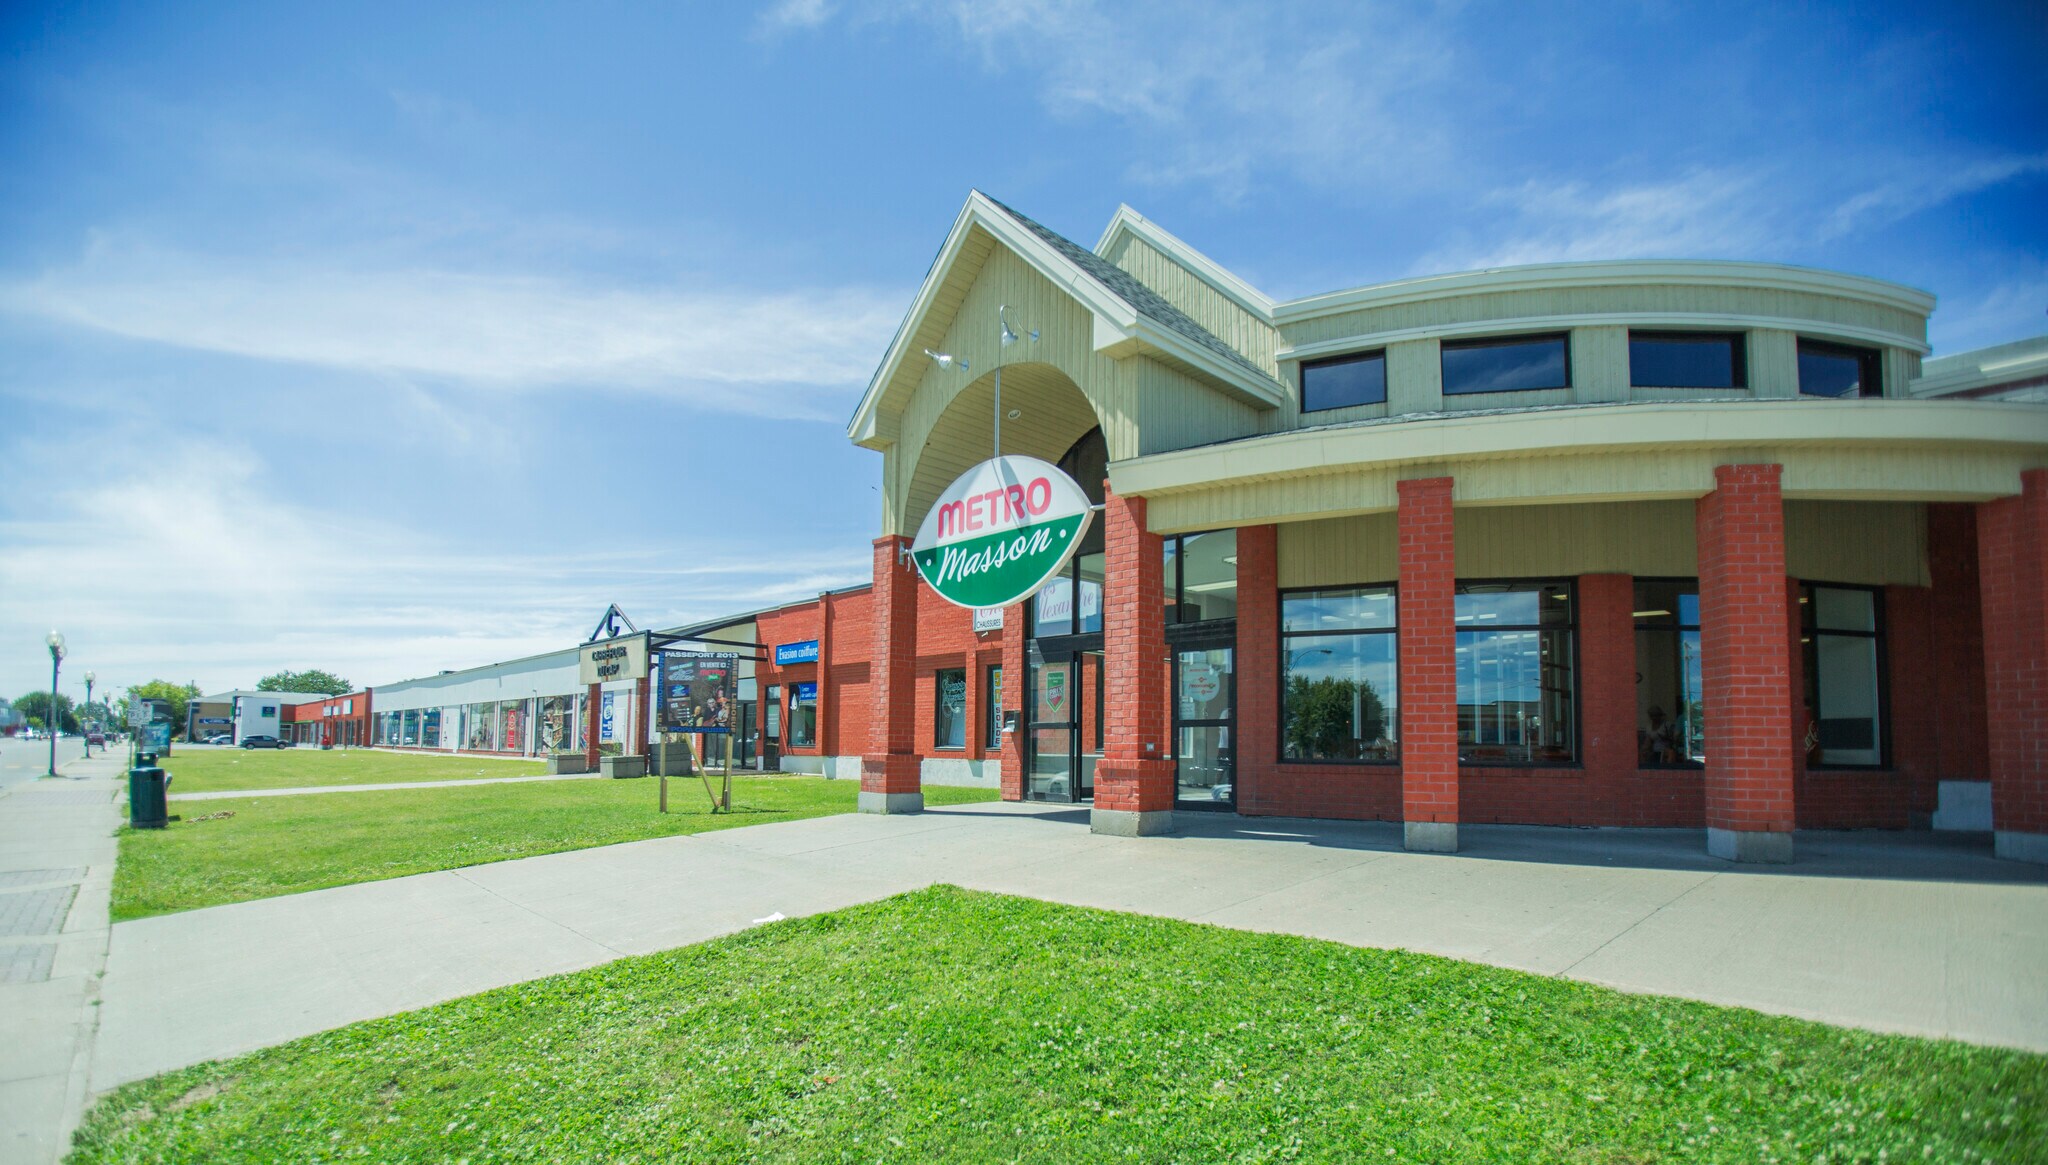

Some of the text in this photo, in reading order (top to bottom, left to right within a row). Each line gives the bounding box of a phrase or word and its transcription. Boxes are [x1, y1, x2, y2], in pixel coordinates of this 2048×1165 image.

[938, 477, 1052, 539] METRO
[936, 527, 1053, 587] Masson
[976, 618, 1001, 629] CHAUSSURES
[798, 644, 818, 658] coiffure
